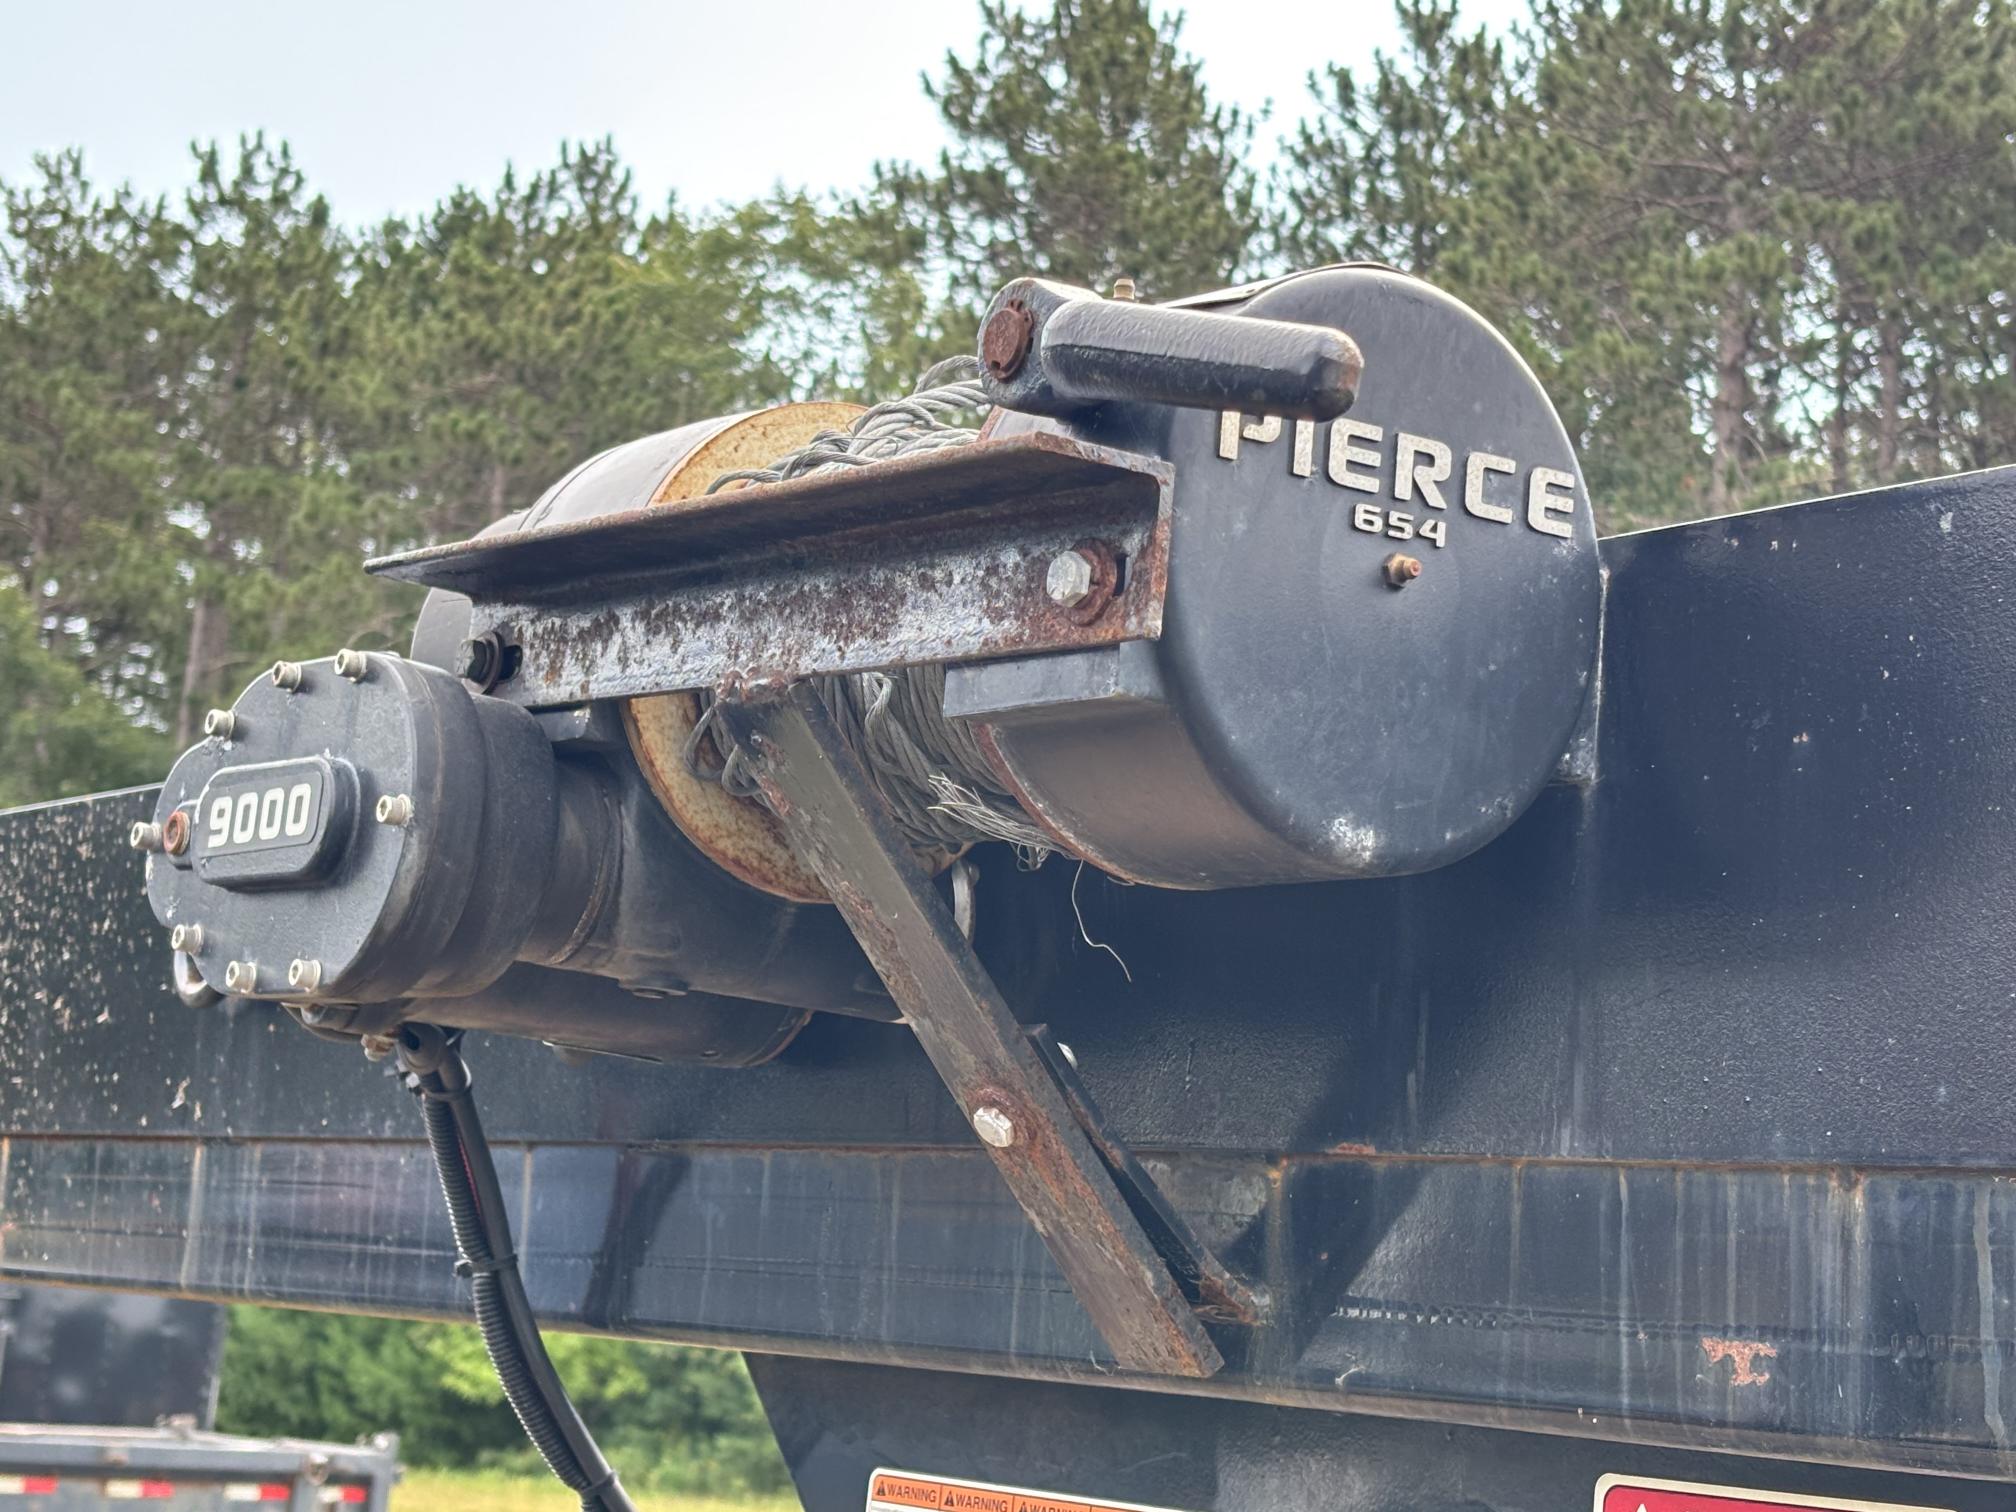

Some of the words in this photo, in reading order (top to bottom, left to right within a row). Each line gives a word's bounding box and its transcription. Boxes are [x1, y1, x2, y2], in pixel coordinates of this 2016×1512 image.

[1219, 411, 1575, 538] PIERCE
[1354, 503, 1446, 548] 654
[208, 783, 311, 848] 9000
[887, 1484, 936, 1502] WARNING
[956, 1493, 1008, 1512] WARNING
